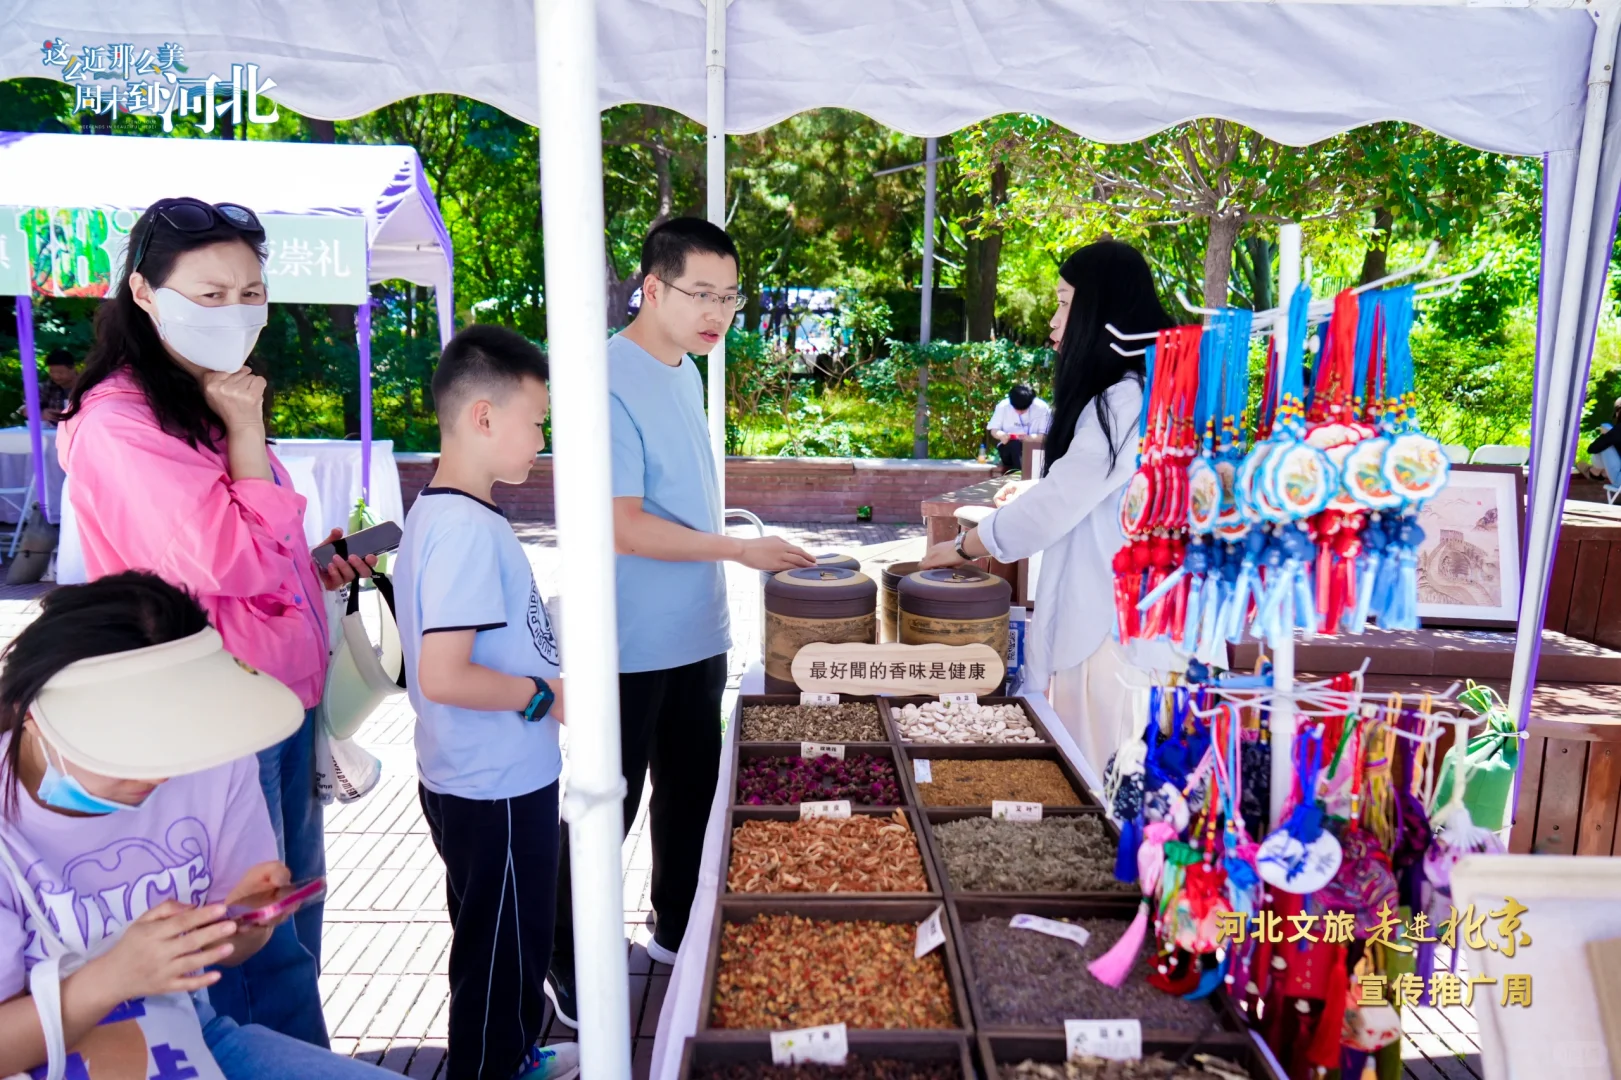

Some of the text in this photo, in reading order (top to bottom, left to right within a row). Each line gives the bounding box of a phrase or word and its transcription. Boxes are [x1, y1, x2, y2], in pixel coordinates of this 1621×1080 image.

[809, 661, 987, 681] 最好聞的香味是健康
